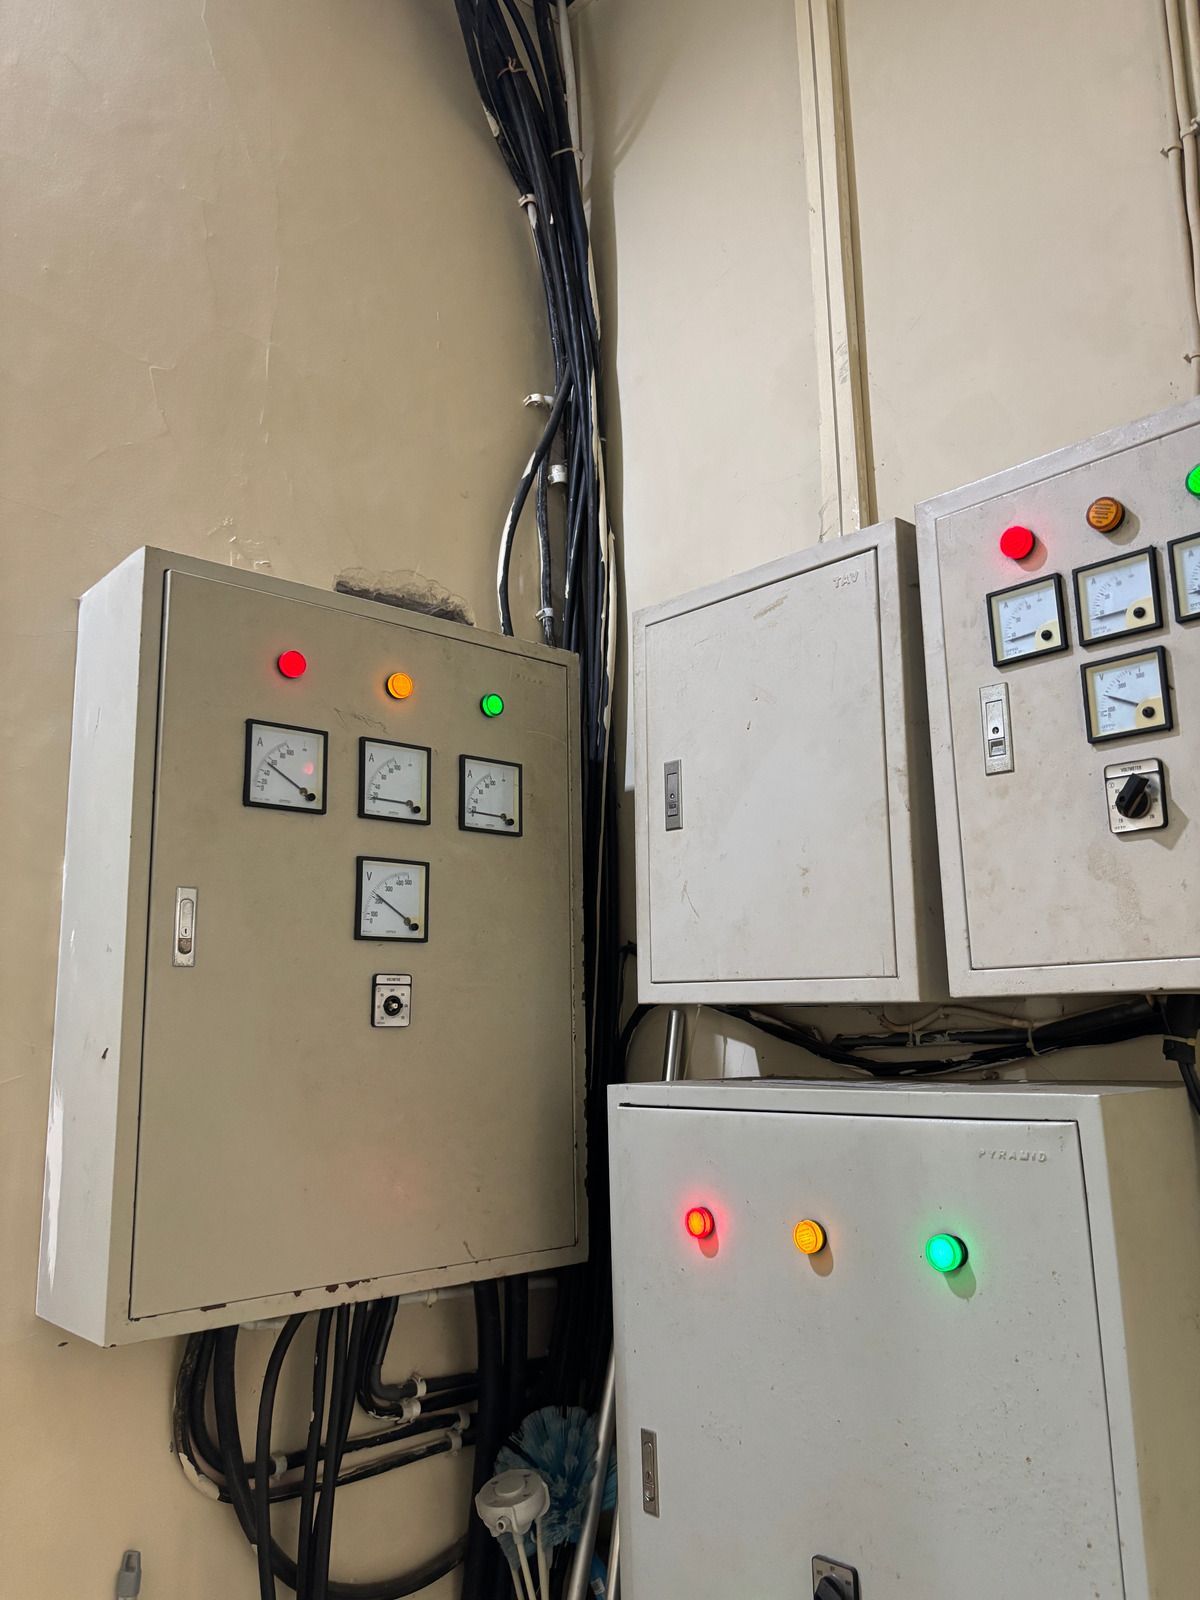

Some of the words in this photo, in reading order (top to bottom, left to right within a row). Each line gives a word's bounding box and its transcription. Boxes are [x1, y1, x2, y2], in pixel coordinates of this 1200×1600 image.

[1091, 577, 1096, 585] A
[257, 737, 264, 747] A
[368, 753, 374, 762] A
[467, 770, 473, 778] A
[366, 872, 372, 881] V
[978, 1150, 1048, 1163] PYRAMID
